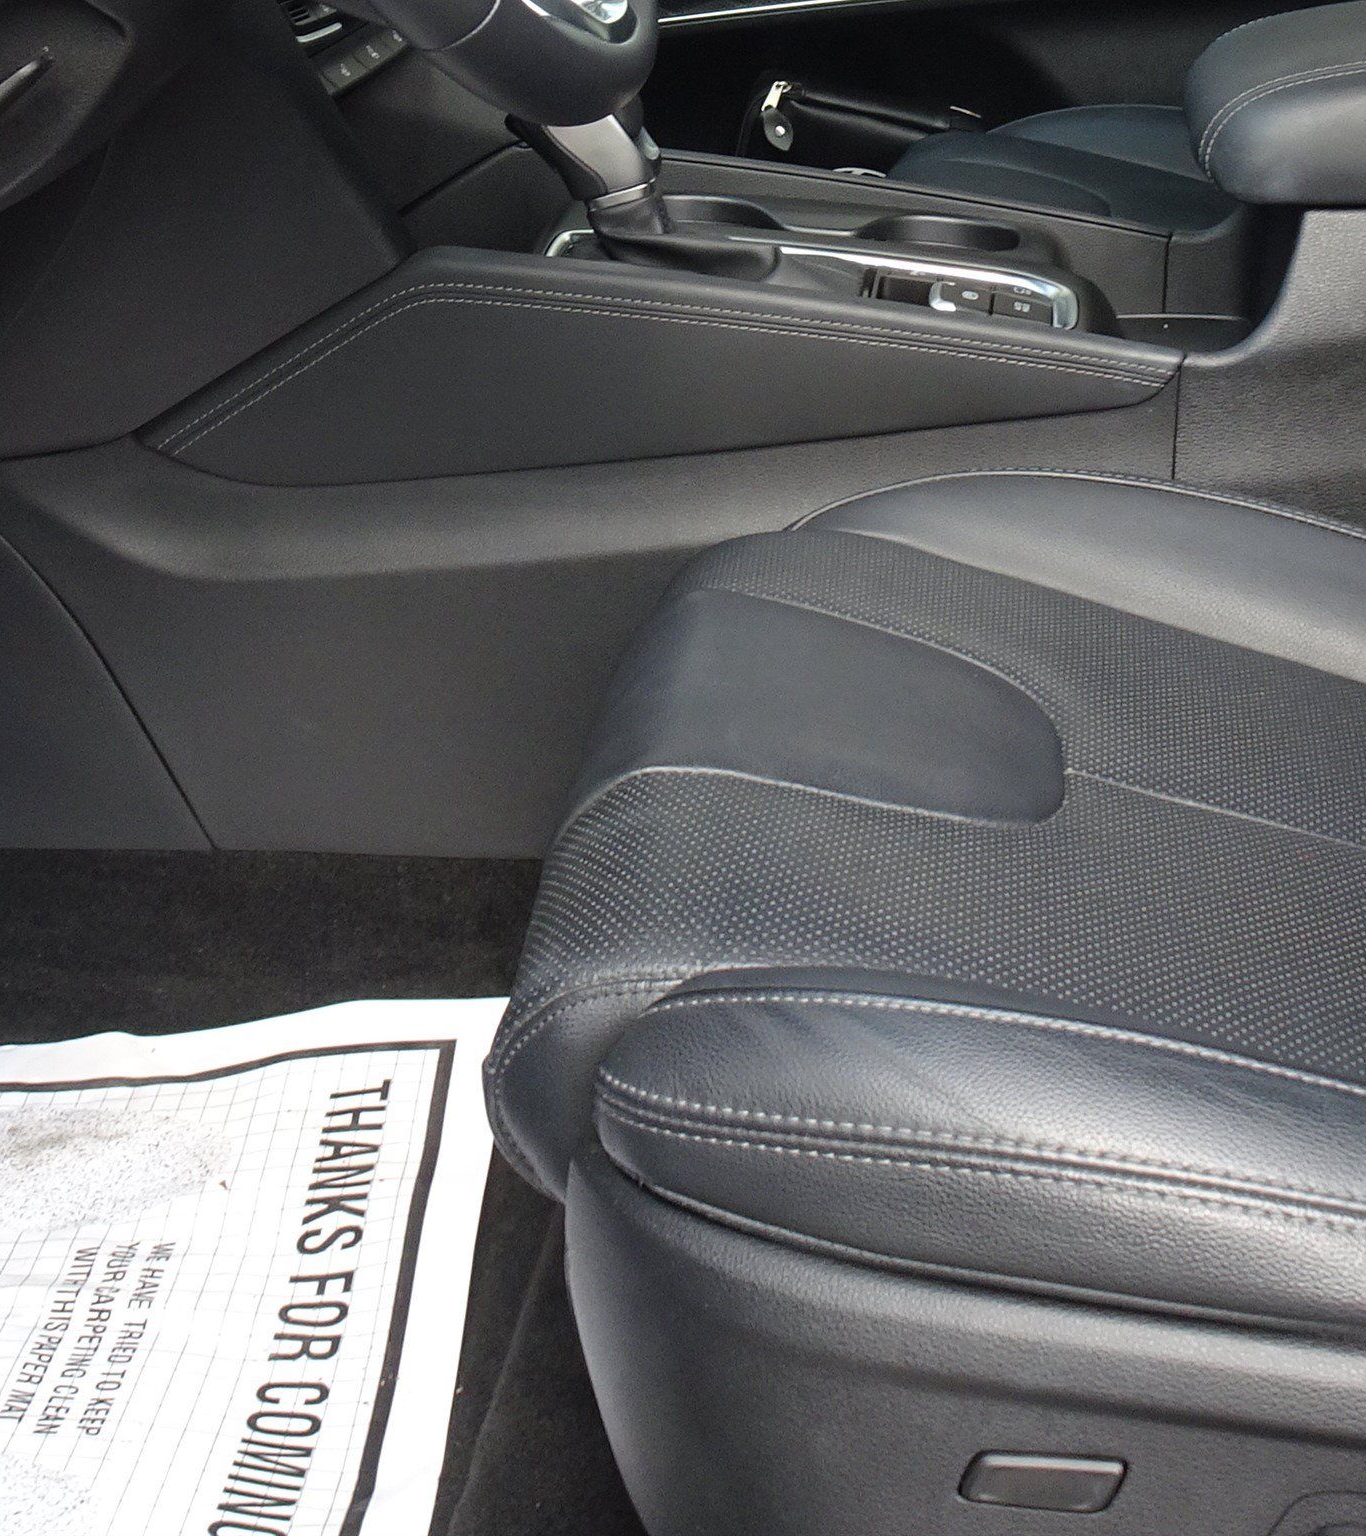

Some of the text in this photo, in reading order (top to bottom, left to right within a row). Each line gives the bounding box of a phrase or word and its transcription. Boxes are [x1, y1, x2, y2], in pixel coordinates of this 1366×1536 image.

[296, 1078, 392, 1256] THANKS
[42, 1287, 83, 1332] THIS
[62, 1246, 101, 1288] WITH
[15, 1334, 63, 1386] PAPER
[32, 1241, 140, 1435] YOUR CARPETING CLEAN
[76, 1241, 176, 1437] WE HAVE TRIED TO KEEP
[267, 1268, 357, 1362] FOR
